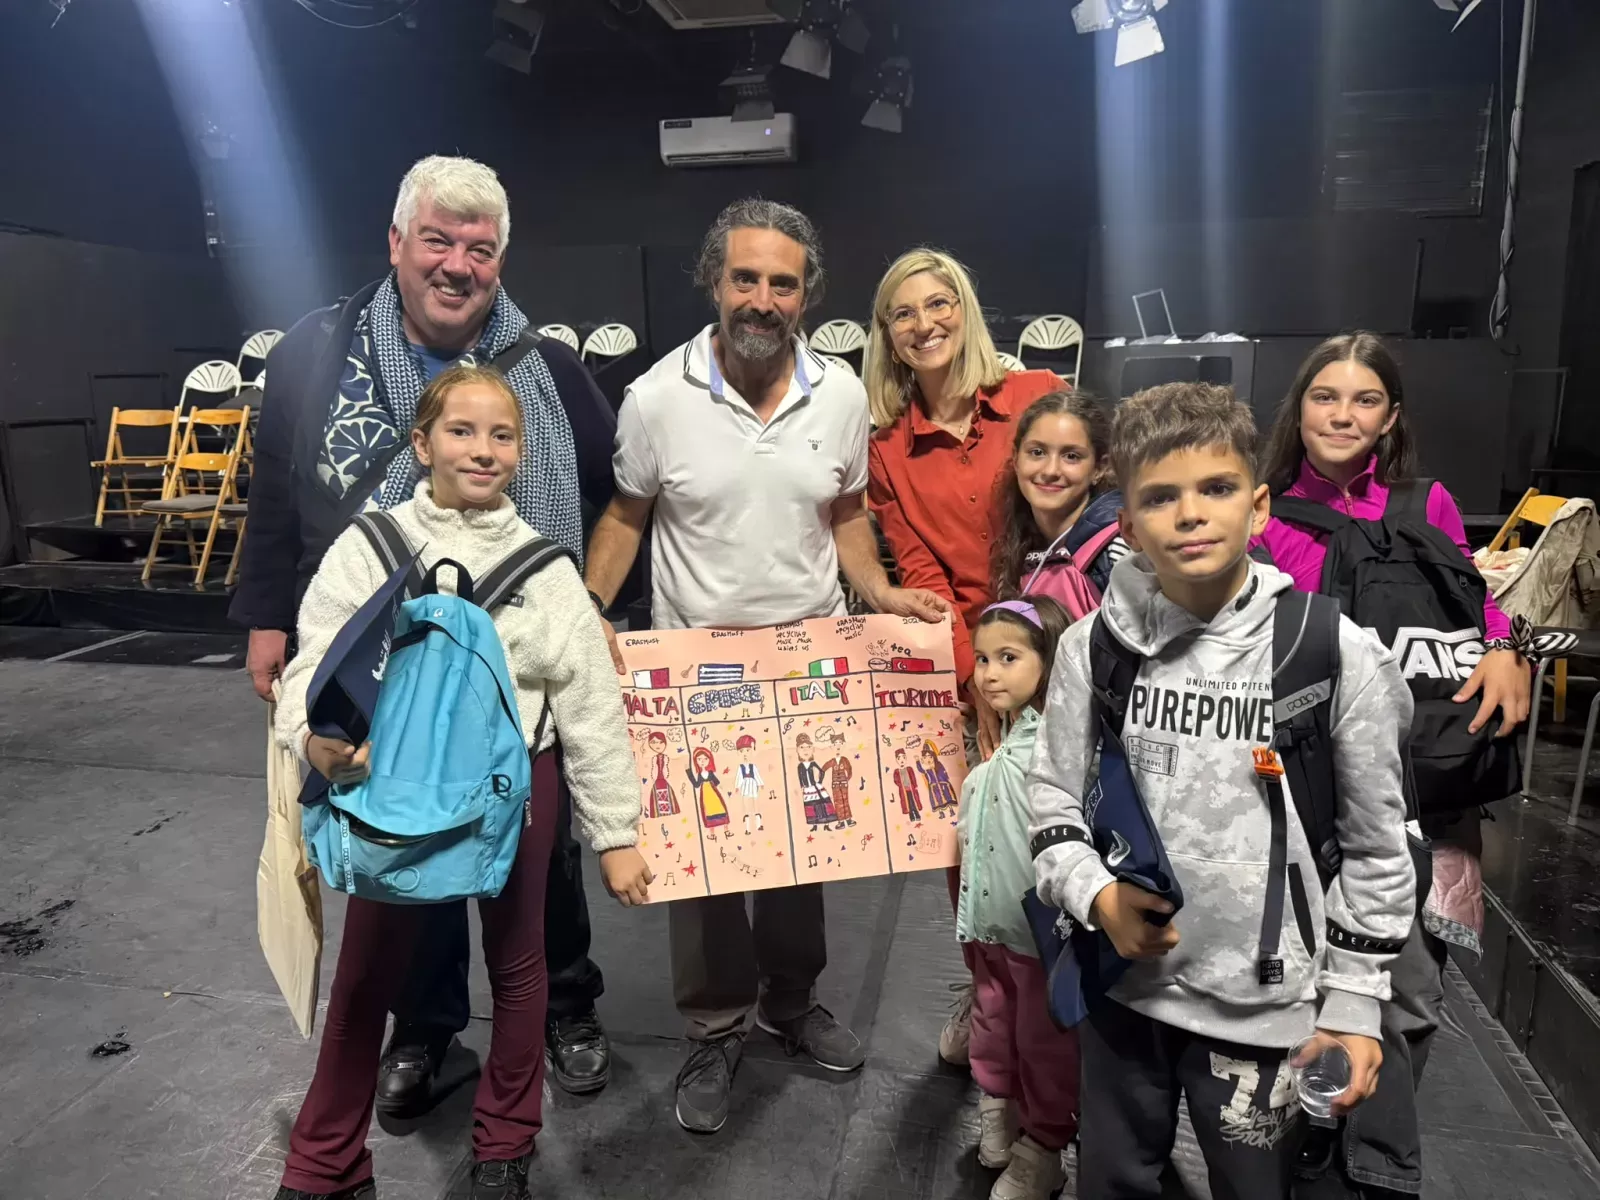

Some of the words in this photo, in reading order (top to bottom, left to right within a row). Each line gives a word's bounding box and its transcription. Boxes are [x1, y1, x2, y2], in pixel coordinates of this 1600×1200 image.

[790, 678, 849, 705] ITALY
[1186, 677, 1237, 690] UNLIMITED
[1286, 693, 1314, 712] POLO
[1042, 828, 1067, 839] THE
